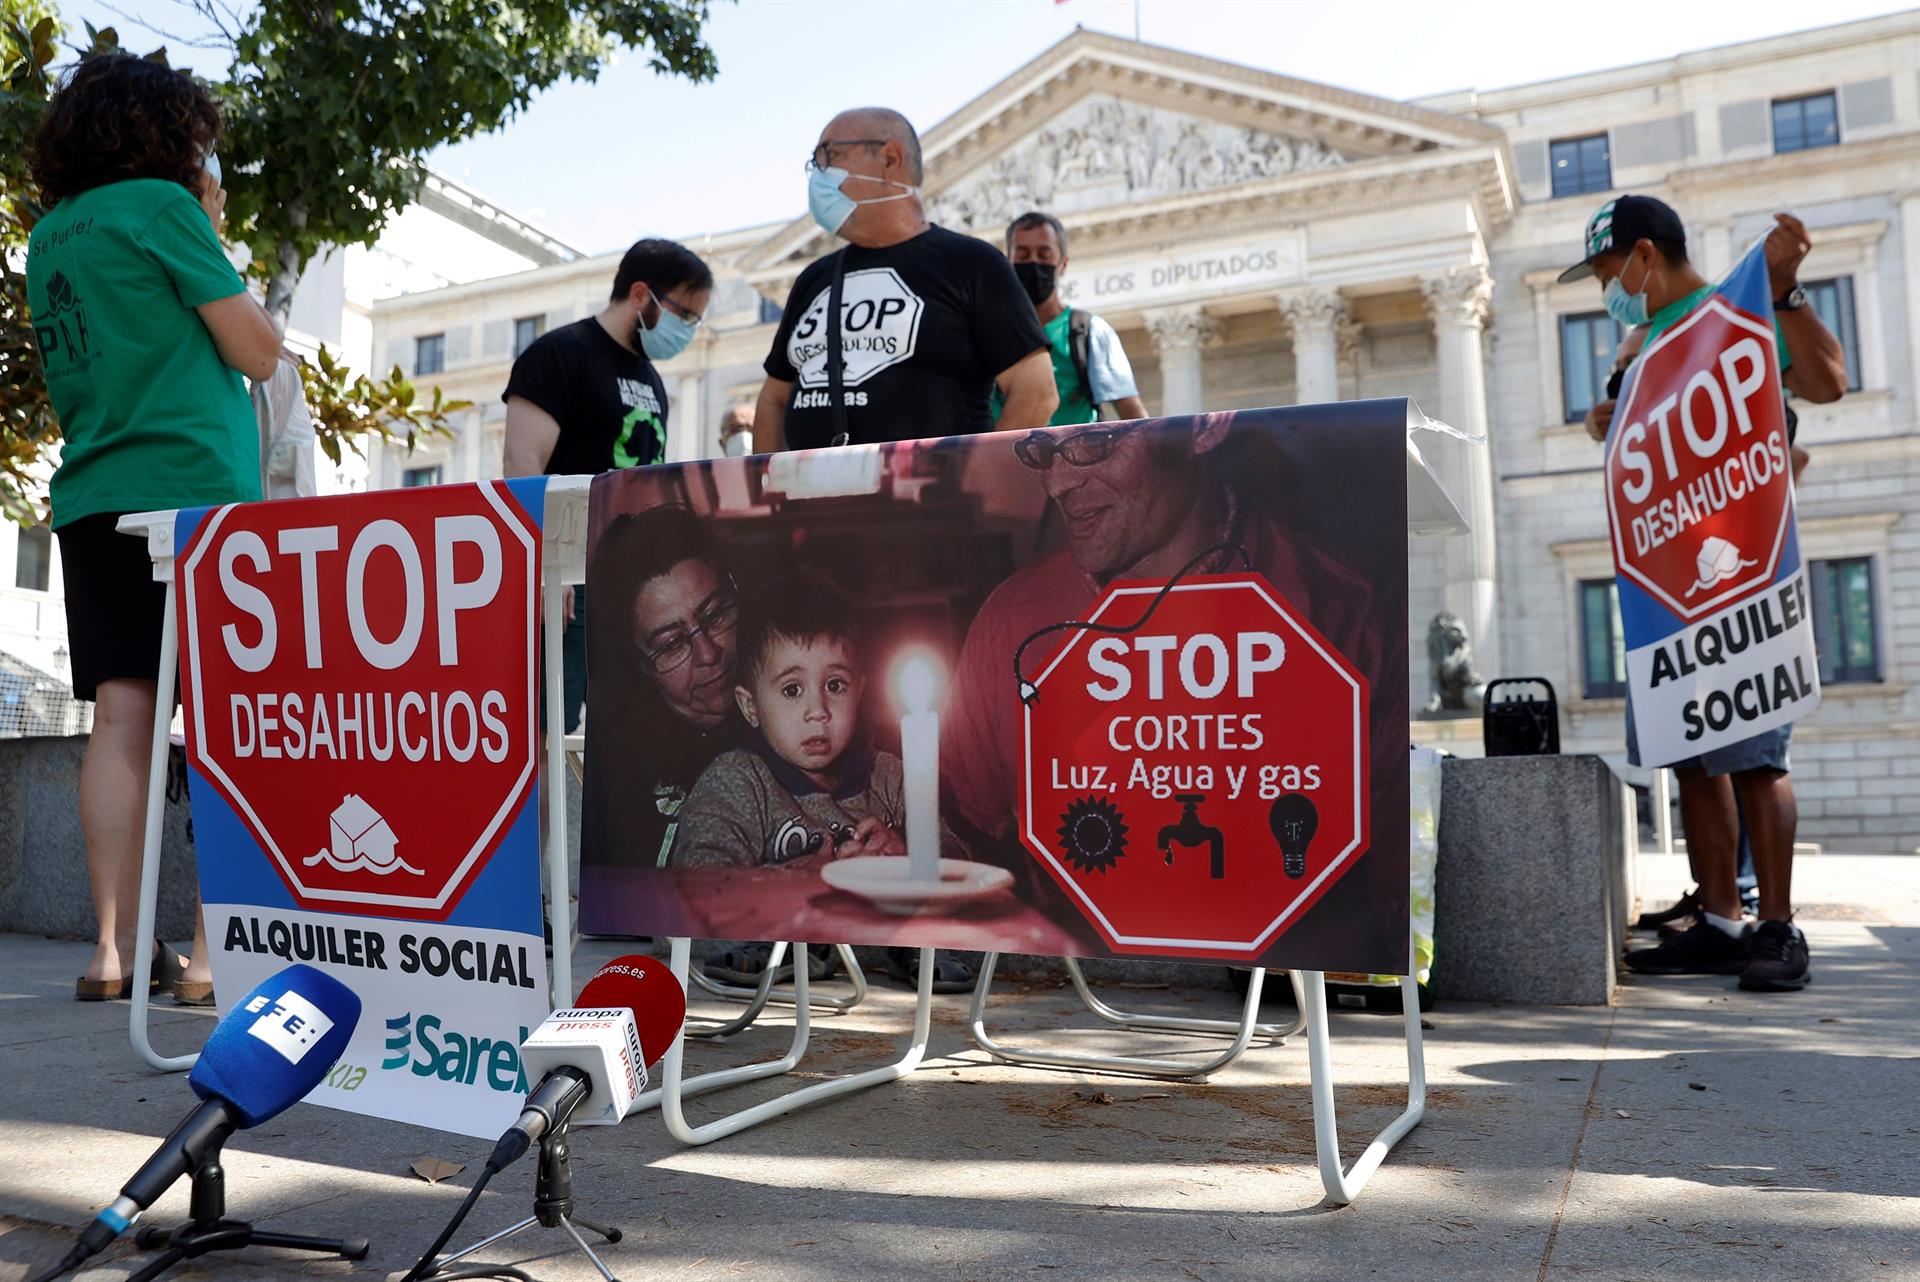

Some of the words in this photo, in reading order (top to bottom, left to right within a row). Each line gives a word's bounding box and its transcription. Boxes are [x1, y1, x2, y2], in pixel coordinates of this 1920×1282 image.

[33, 240, 48, 257] Se
[1094, 271, 1135, 297] LOS
[1151, 250, 1279, 288] DIPUTADOS
[793, 389, 869, 410] Astuas
[1619, 337, 1767, 504] STOP
[1630, 430, 1787, 558] DESAHUCIOS
[218, 514, 504, 673] STOP
[1086, 631, 1286, 701] STOP
[1683, 655, 1812, 741] SOCIAL
[230, 690, 509, 763] DESAHUCIOS
[1108, 714, 1264, 751] CORTES
[1052, 758, 1118, 793] Luz,
[1127, 759, 1214, 799] Agua
[1225, 765, 1247, 800] y
[1258, 764, 1321, 800] gas
[224, 916, 388, 970] ALQUILER
[400, 934, 535, 989] SOCIAL
[594, 964, 646, 979] press.es
[556, 1010, 623, 1019] europa
[556, 1021, 614, 1032] press
[619, 1046, 637, 1101] press
[627, 1022, 646, 1088] europa
